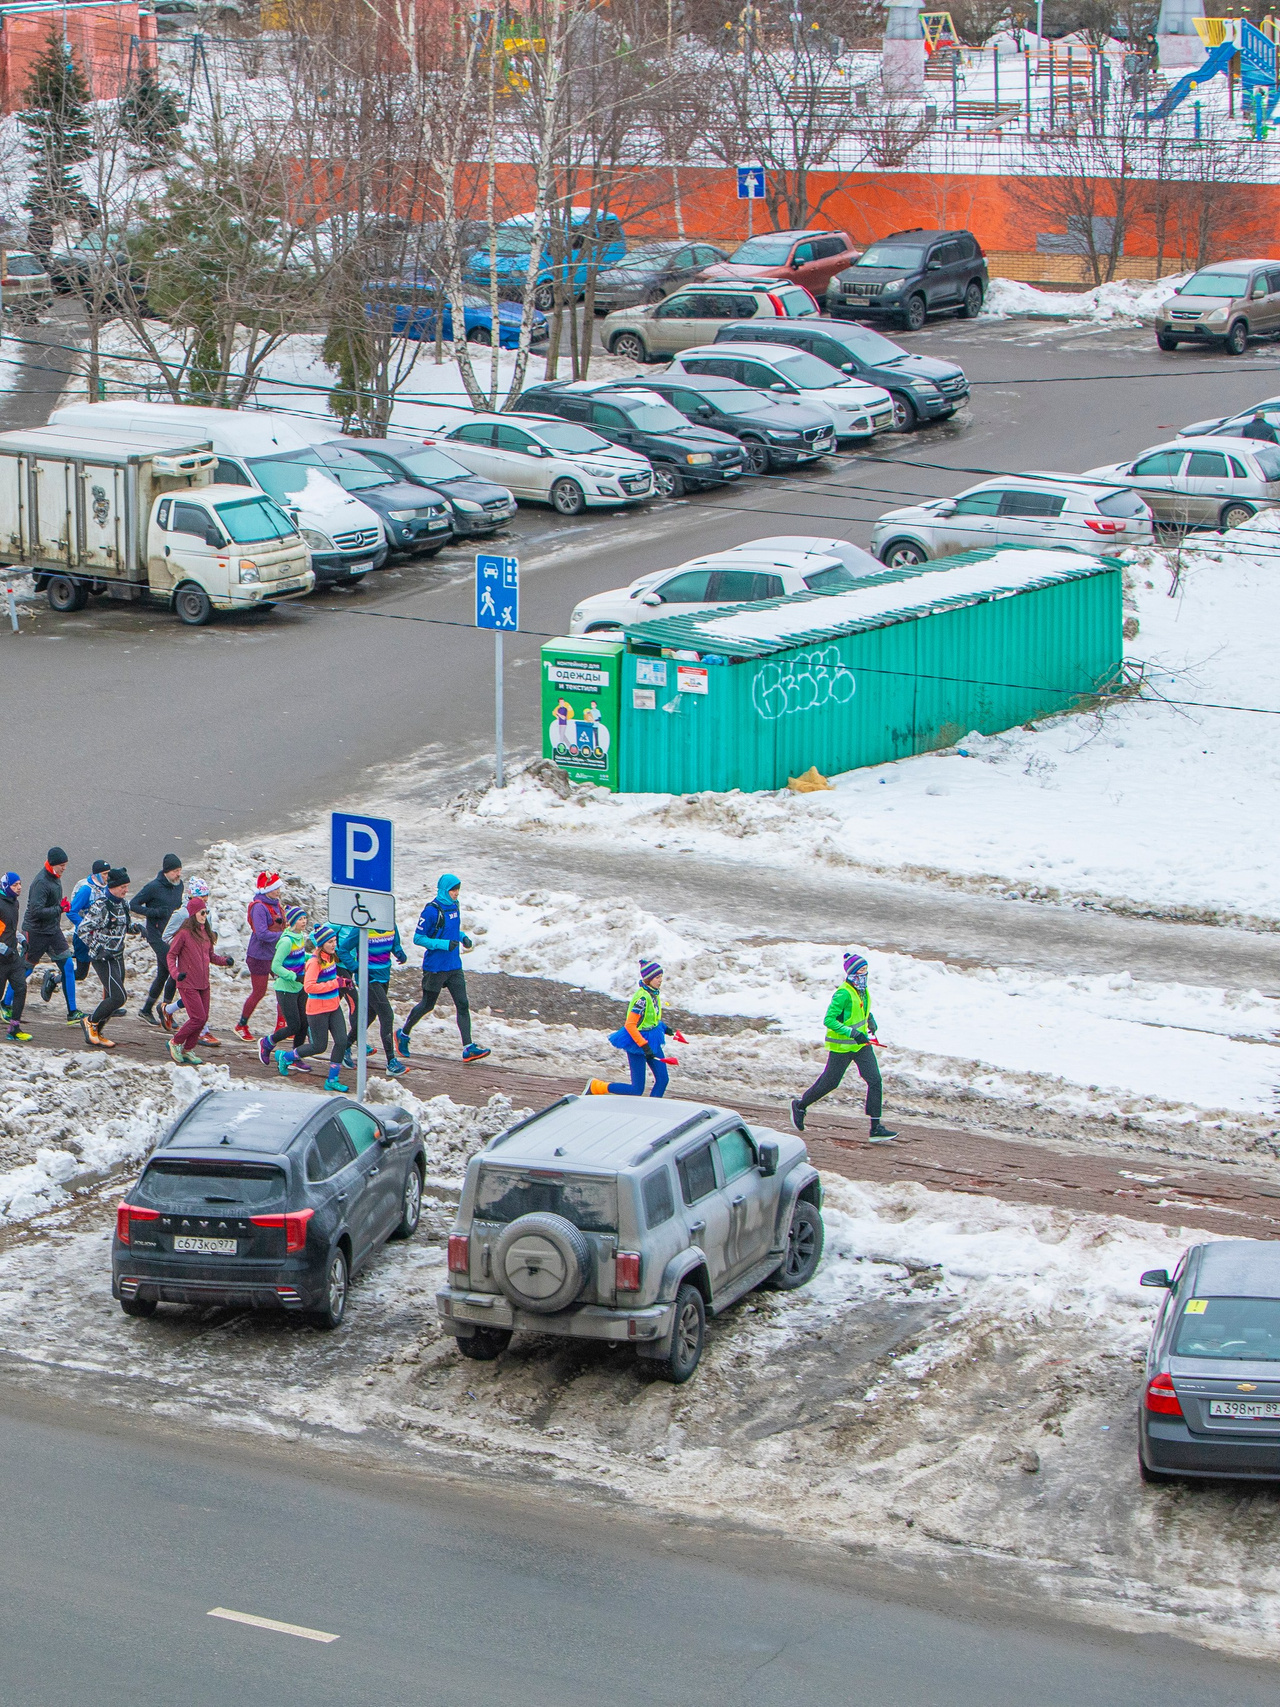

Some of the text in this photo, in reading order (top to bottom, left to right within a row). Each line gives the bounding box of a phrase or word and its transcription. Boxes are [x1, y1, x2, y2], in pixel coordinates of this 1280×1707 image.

[556, 670, 601, 682] одежды
[346, 822, 380, 880] P
[163, 1218, 246, 1229] HAVAL
